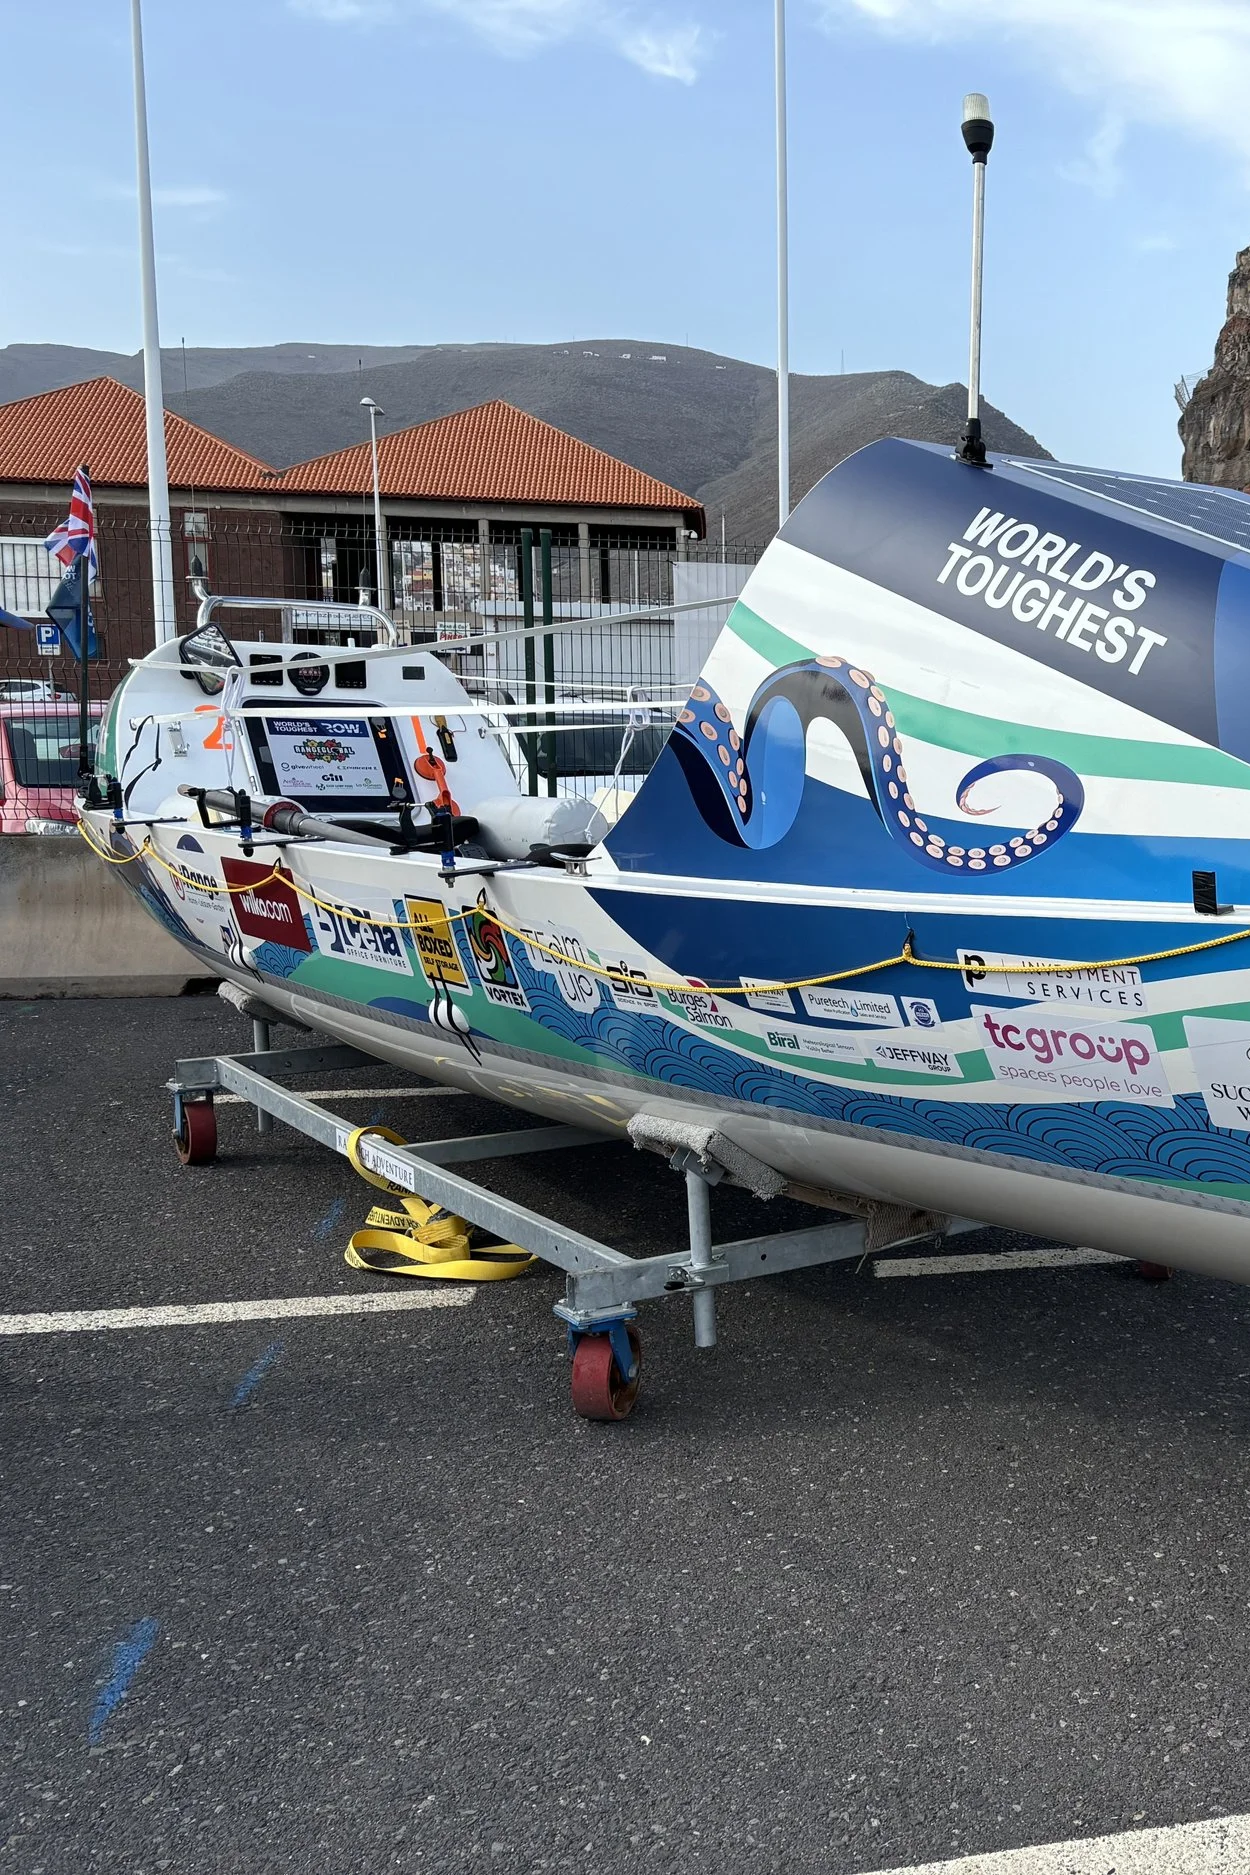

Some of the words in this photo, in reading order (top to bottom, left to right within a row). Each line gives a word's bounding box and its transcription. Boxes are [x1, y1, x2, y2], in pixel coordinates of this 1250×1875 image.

[962, 506, 1156, 611] WORLD'S
[936, 542, 1168, 676] TOUGHEST
[41, 627, 54, 642] P
[321, 722, 360, 734] ROW
[322, 773, 343, 782] Gill
[239, 886, 293, 924] wilko.com
[416, 933, 453, 959] BOXED
[347, 948, 369, 959] OFFICE
[370, 953, 407, 969] FURNITURE
[435, 959, 460, 971] STORAGE
[1022, 961, 1137, 986] INVESTMENT
[485, 986, 527, 1008] VORTEX
[667, 989, 707, 1009] Burges
[808, 993, 849, 1010] Puretech
[854, 999, 891, 1014] Limited
[1027, 982, 1143, 1007] SERVICES
[686, 1006, 733, 1028] Salmon
[767, 1031, 801, 1050] Biral
[886, 1047, 948, 1066] JEFFWAY
[928, 1064, 952, 1073] GROUP
[999, 1062, 1056, 1084] spaces
[1062, 1073, 1120, 1094] people
[1125, 1077, 1162, 1098] love
[372, 1151, 413, 1186] ADVENTURE
